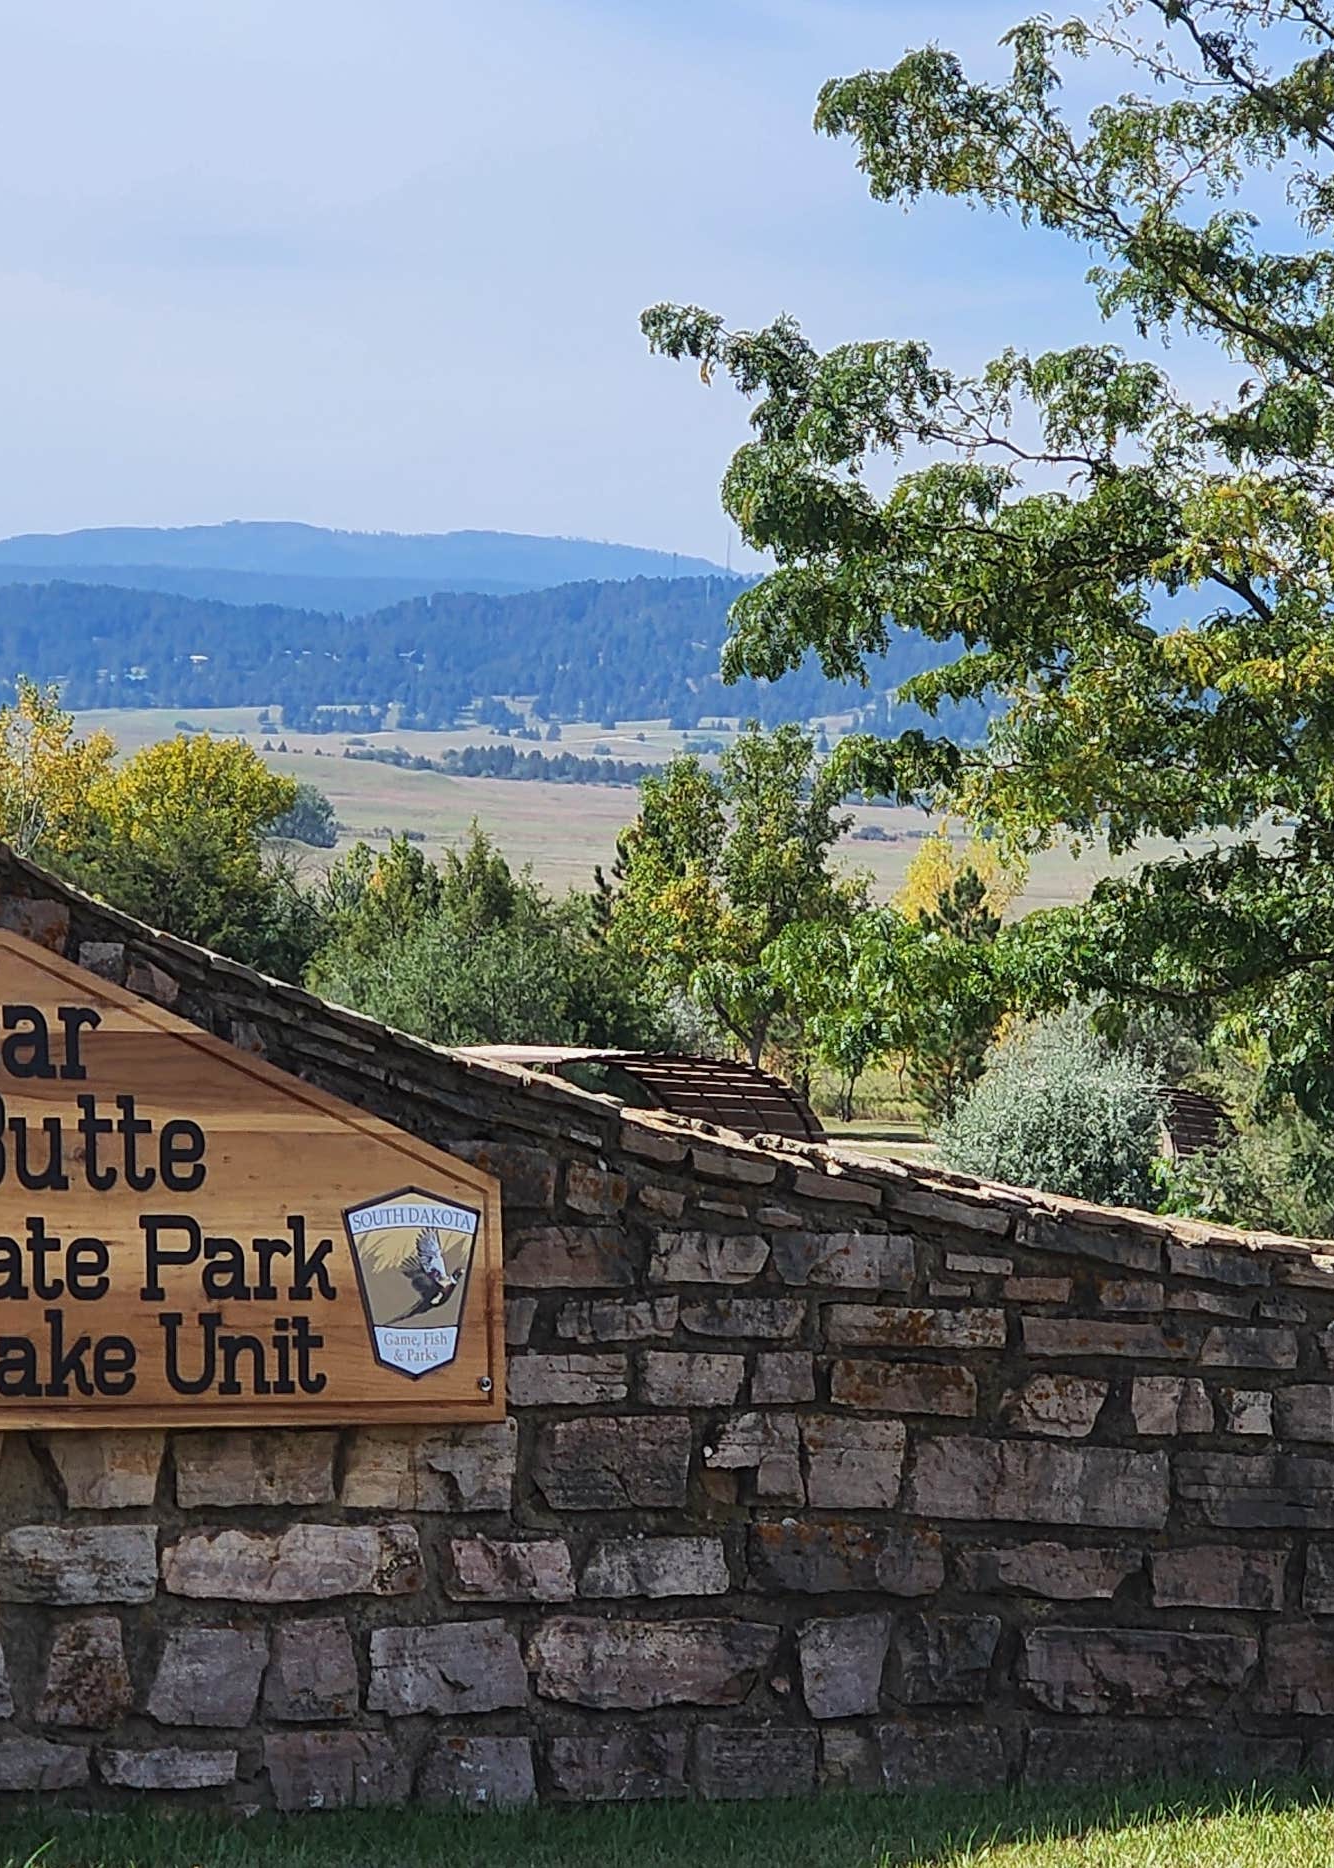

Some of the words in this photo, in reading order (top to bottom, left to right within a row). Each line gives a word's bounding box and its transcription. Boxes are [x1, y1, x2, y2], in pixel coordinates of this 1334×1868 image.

[352, 1208, 404, 1230] SOUTH
[409, 1208, 473, 1230] DAKOTA
[139, 1214, 337, 1300] Park
[384, 1332, 420, 1347] Game,
[424, 1332, 448, 1346] Fish
[161, 1312, 327, 1395] Unit
[393, 1349, 404, 1361] &
[407, 1348, 438, 1361] Parks
